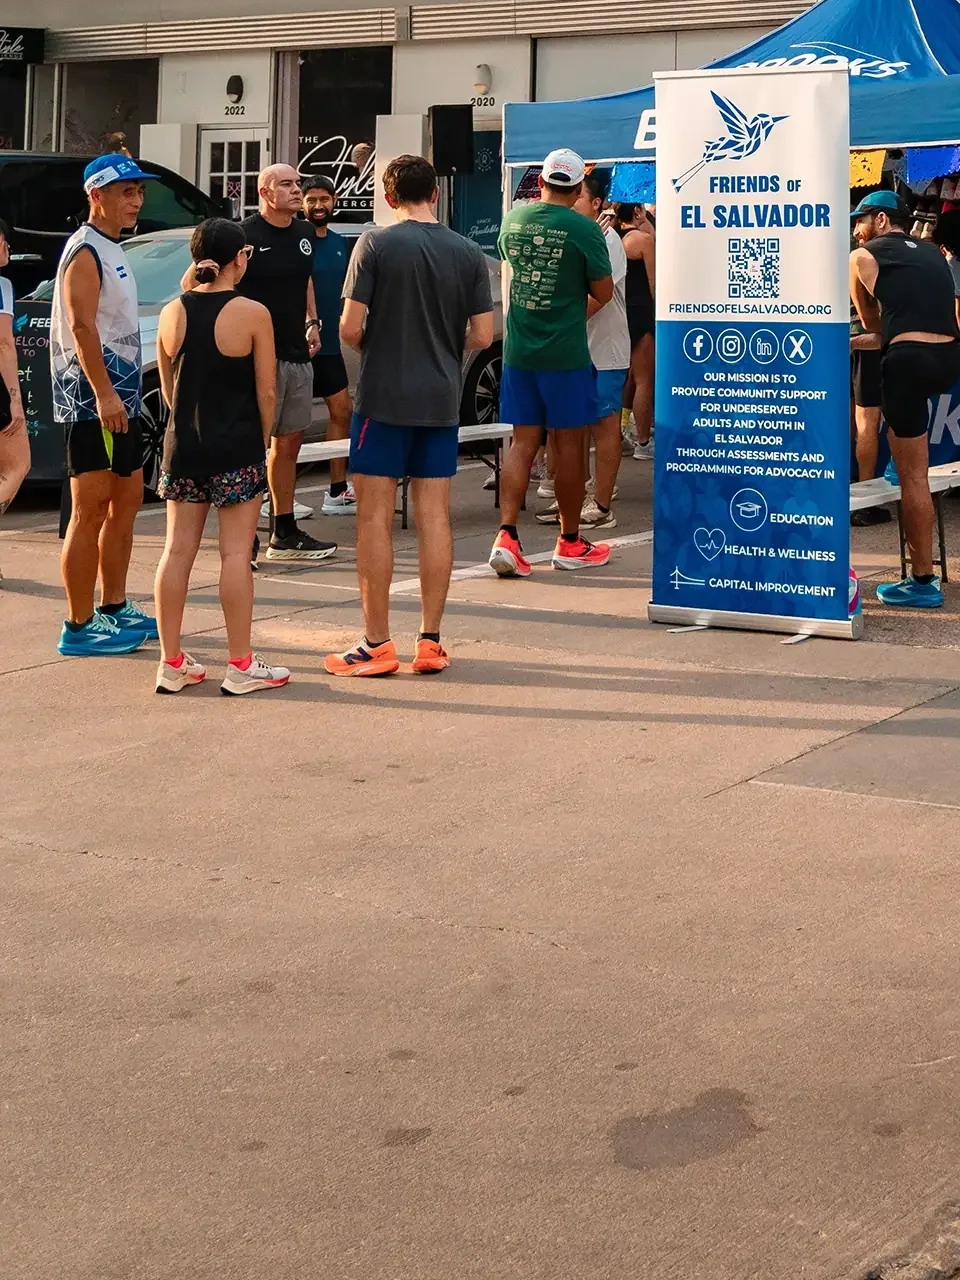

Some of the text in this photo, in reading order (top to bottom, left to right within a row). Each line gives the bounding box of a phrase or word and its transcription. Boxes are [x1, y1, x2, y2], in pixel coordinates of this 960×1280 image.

[470, 97, 495, 107] 2020
[224, 106, 246, 116] 2022
[710, 176, 801, 193] FRIENDS OF
[681, 204, 830, 228] EL SALVADOR
[669, 303, 832, 315] FRIENDSOFELSALVADOR.ORG
[29, 317, 51, 327] FEE
[16, 335, 50, 348] ELCO
[22, 349, 36, 357] TO
[704, 373, 796, 383] OUR MISSION IS TO
[672, 387, 827, 400] PROVIDE COMMUNITY SUPPORT
[701, 403, 798, 414] FOR UNDERSERVED
[693, 418, 805, 430] ADULTS AND YOUTH IN
[715, 434, 783, 445] EL SALVADOR
[676, 448, 824, 463] THROUGH ASSESSMENTS AND
[666, 463, 834, 479] PROGRAMMING FOR ADVOCACY IN
[770, 513, 834, 526] EDUCATION
[725, 544, 836, 562] HEALTH & WELLNESS
[709, 578, 836, 597] CAPITAL IMPROVEMENT
